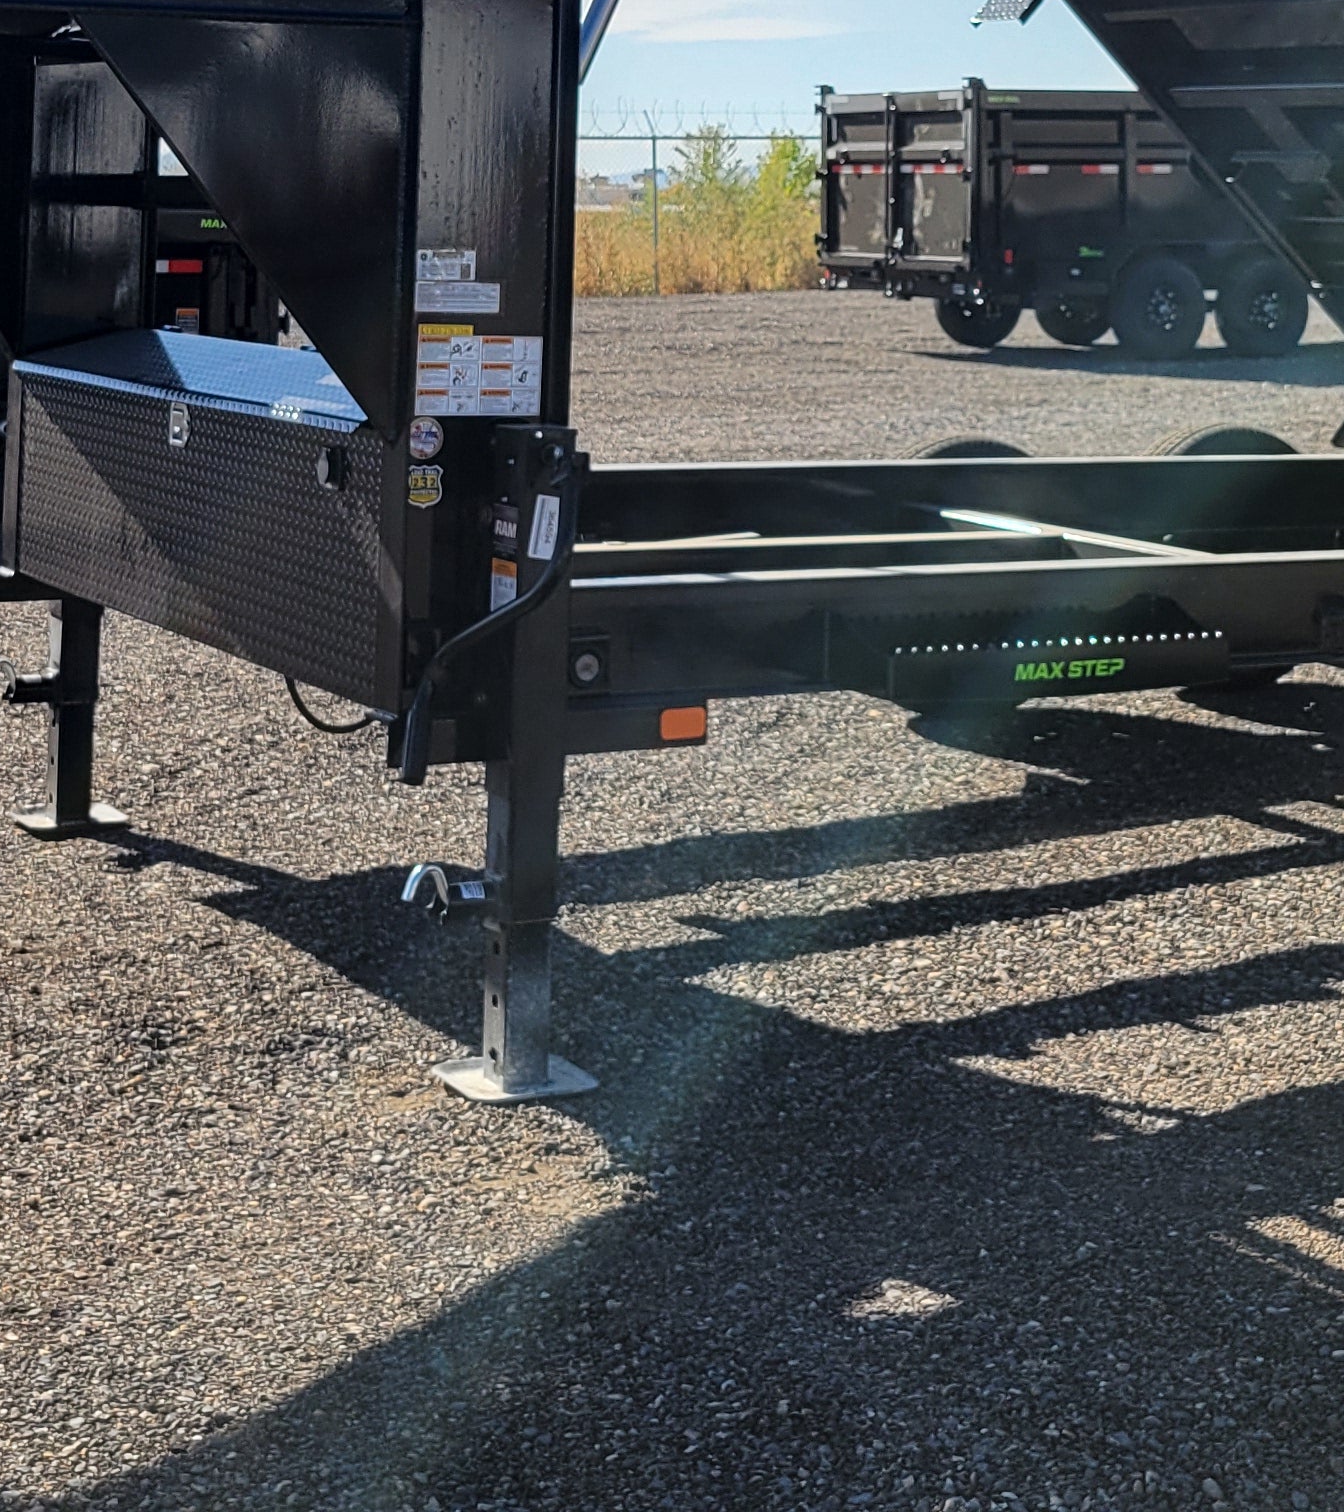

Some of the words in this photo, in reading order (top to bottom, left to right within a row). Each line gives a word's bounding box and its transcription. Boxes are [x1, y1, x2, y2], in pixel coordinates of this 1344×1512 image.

[495, 519, 517, 539] RAM
[1014, 661, 1066, 681] MAX
[1067, 657, 1126, 678] STEP
